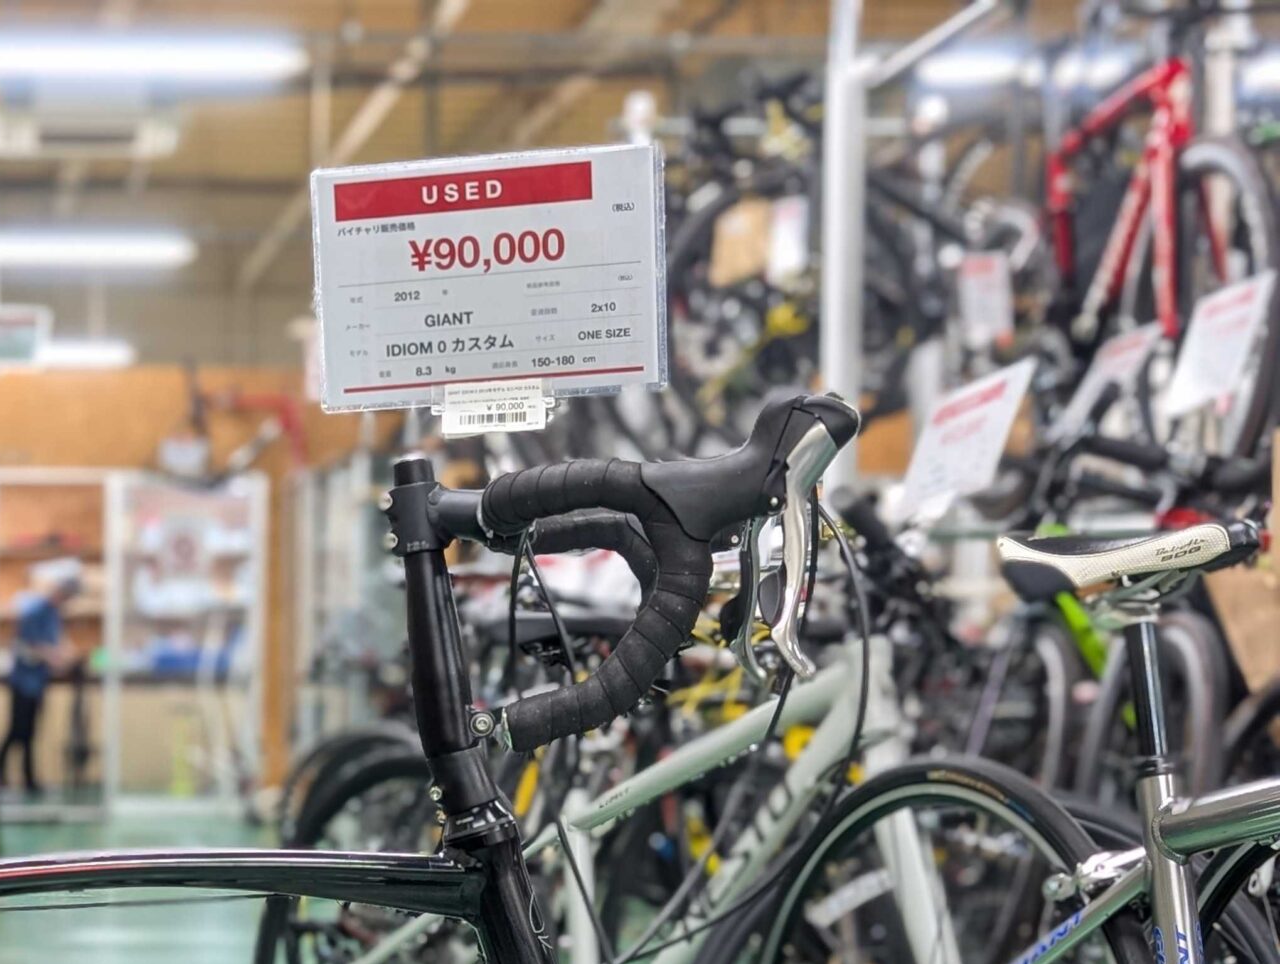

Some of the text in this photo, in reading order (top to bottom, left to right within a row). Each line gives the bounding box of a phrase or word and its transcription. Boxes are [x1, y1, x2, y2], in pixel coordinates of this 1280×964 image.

[422, 179, 503, 204] USED
[409, 228, 565, 274] ¥90,000
[394, 290, 421, 302] 2012
[591, 302, 617, 313] 2x10
[424, 311, 474, 328] GIANT
[577, 328, 631, 341] ONE SIZE
[386, 341, 433, 358] IDIOM
[452, 334, 515, 353] カスタム
[531, 355, 596, 368] 150-180 cm
[415, 366, 432, 377] 8.3
